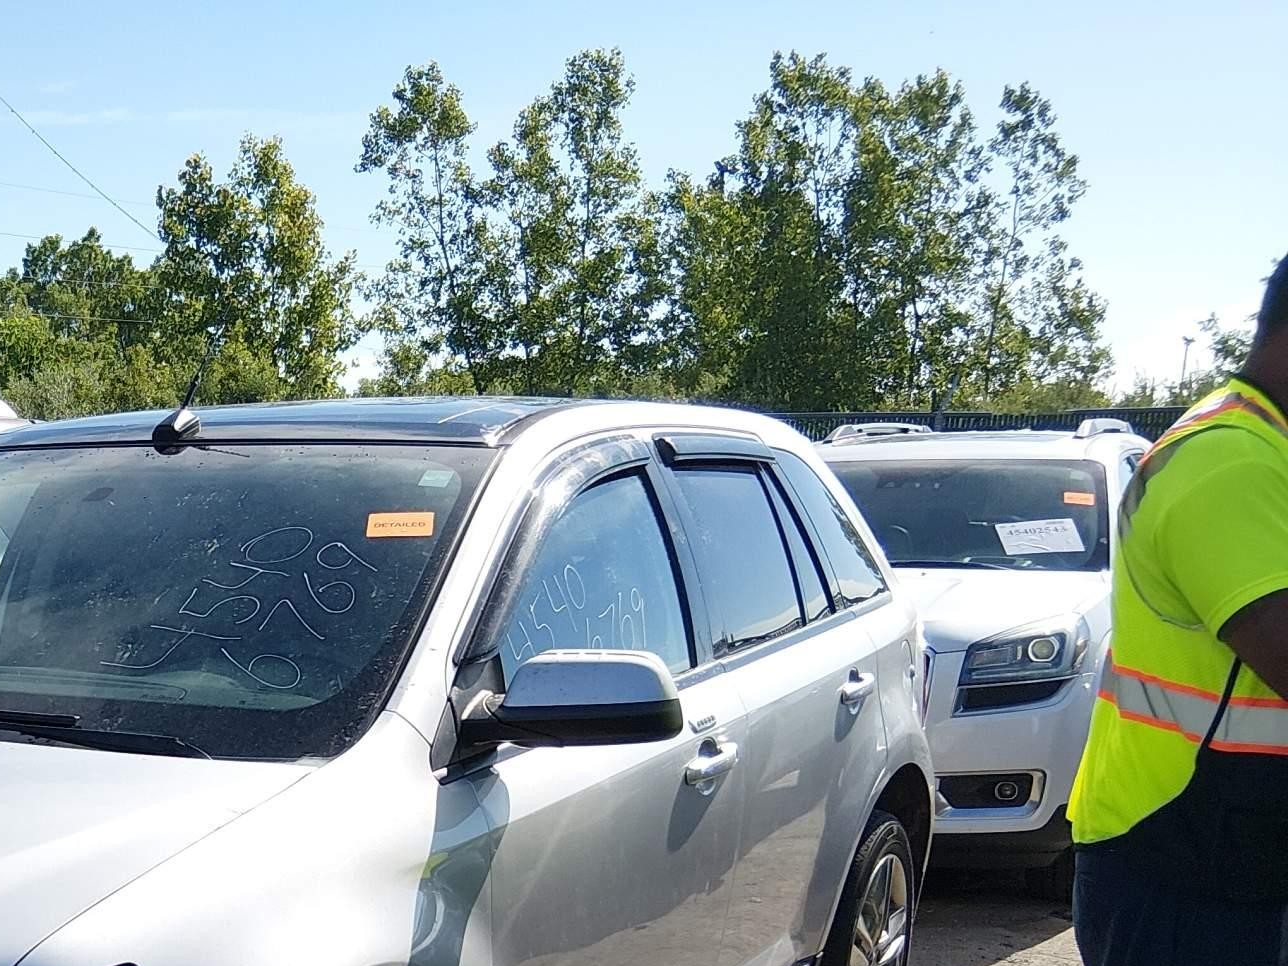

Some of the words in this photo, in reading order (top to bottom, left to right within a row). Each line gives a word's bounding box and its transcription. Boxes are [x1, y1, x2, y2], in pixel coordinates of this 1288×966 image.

[373, 520, 426, 529] DETAILED
[99, 525, 314, 669] 4540
[219, 541, 379, 690] 6769
[506, 563, 587, 661] 4540
